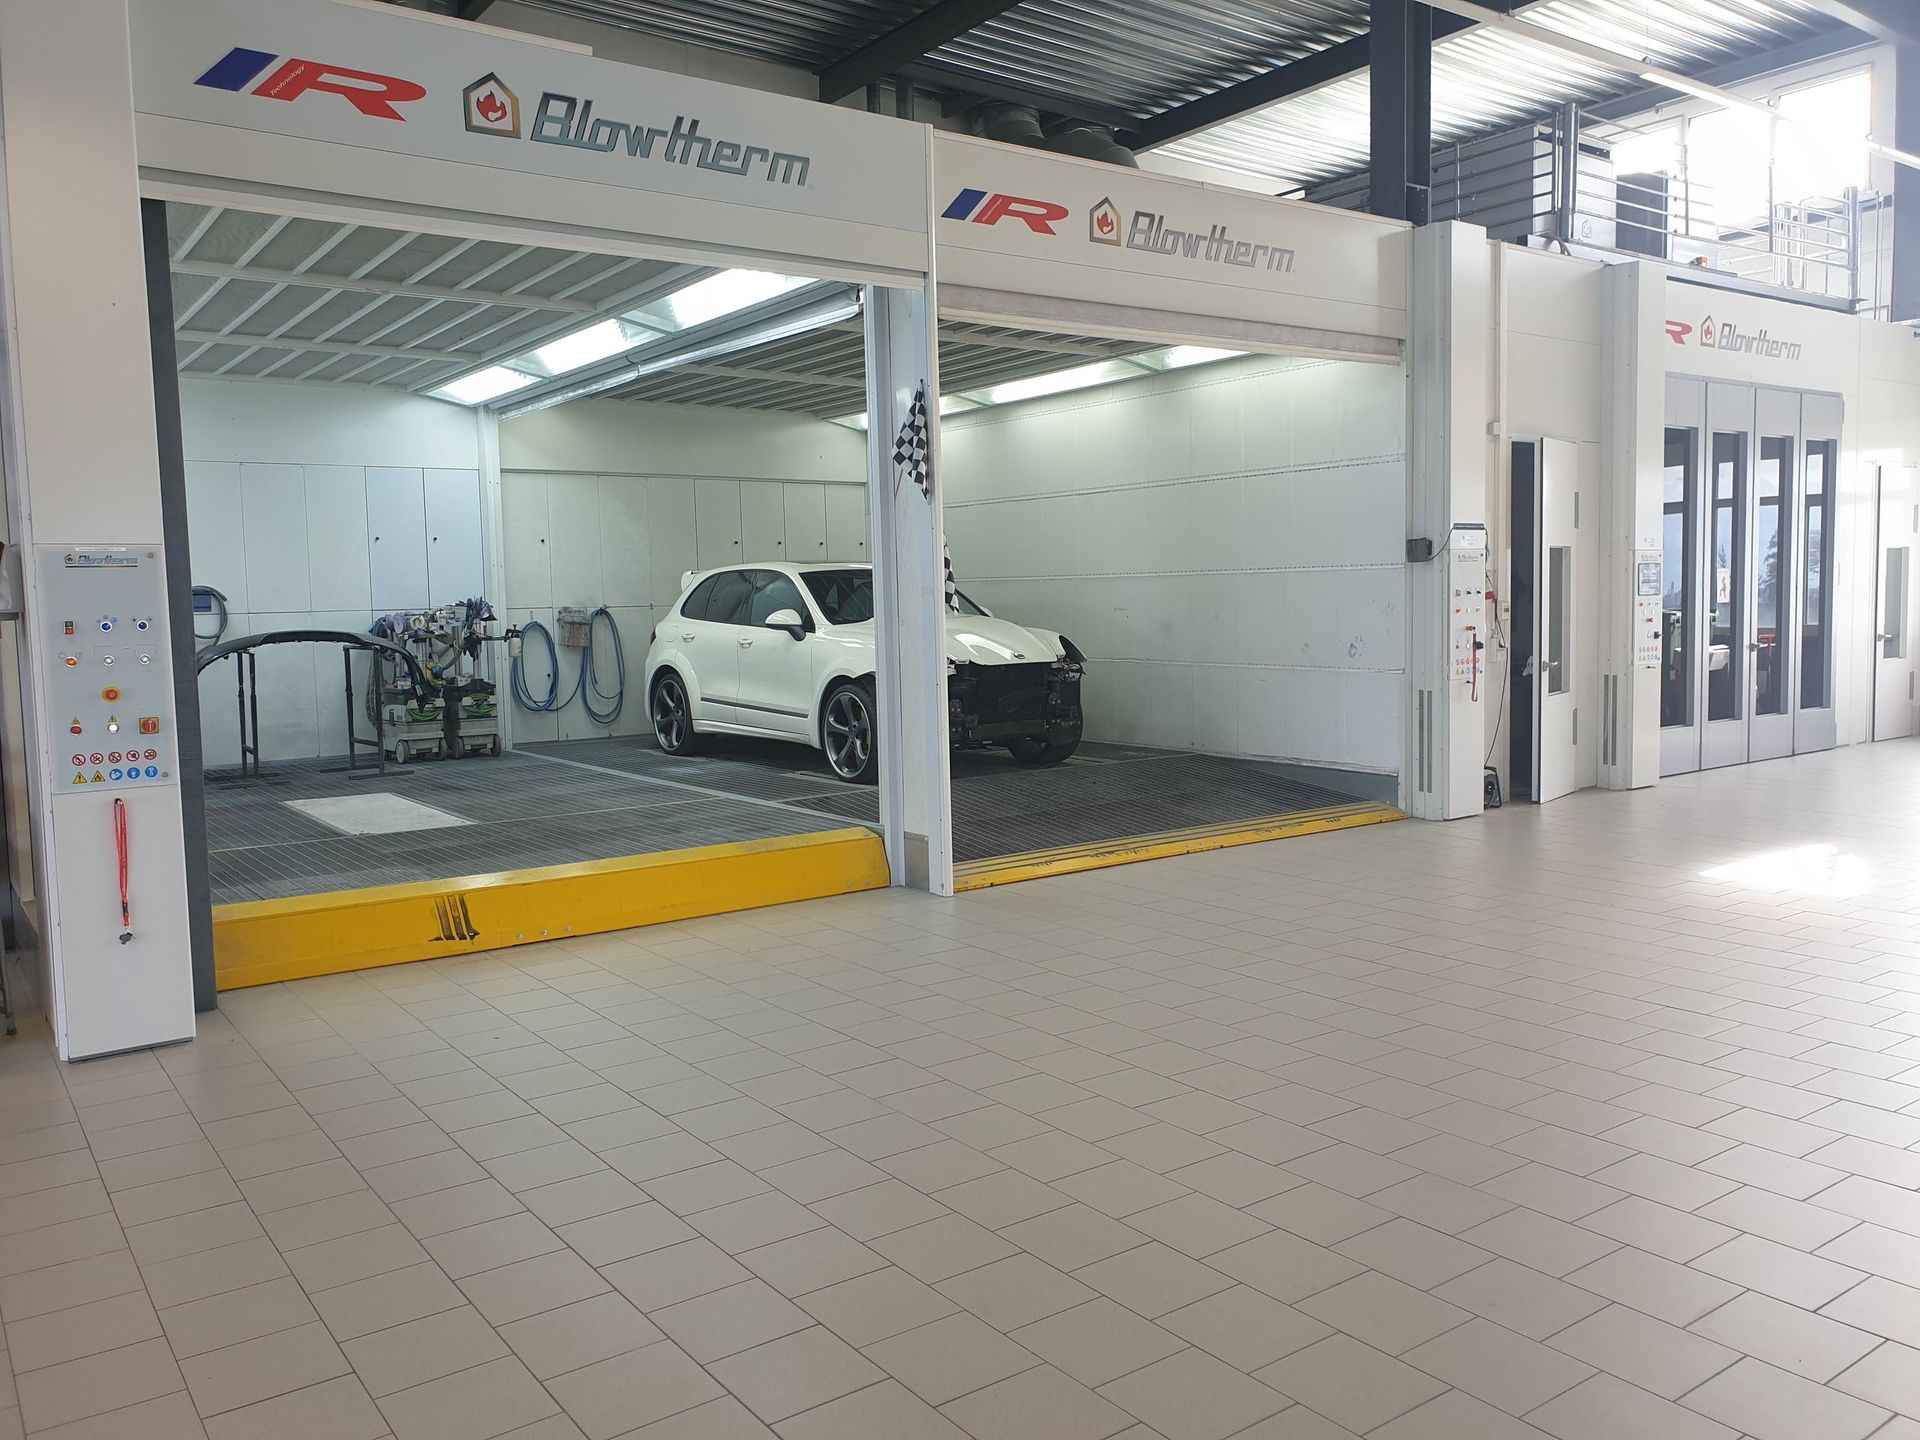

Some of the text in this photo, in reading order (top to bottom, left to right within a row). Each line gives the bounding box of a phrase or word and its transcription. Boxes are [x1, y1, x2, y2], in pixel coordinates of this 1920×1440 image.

[270, 63, 306, 97] Technology
[530, 91, 811, 187] Blowtherm
[1126, 210, 1295, 273] Blowtherm
[1717, 322, 1802, 361] Blowtherm
